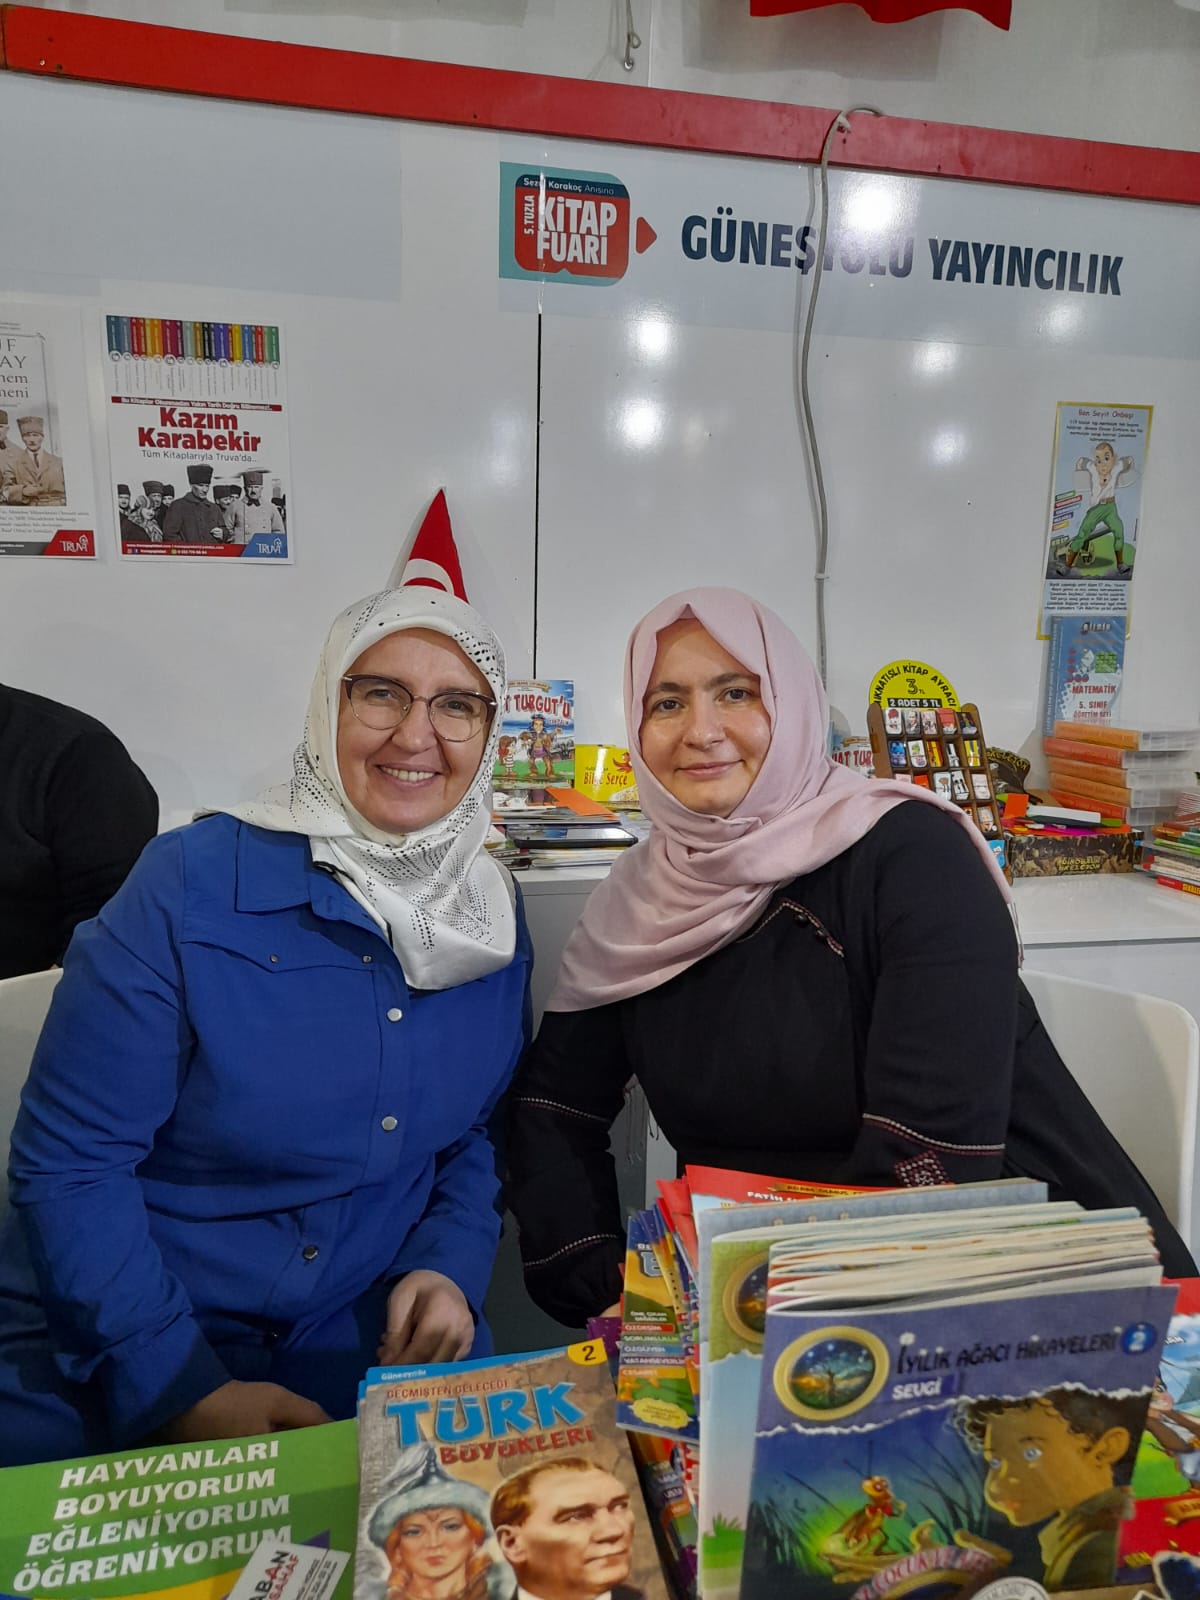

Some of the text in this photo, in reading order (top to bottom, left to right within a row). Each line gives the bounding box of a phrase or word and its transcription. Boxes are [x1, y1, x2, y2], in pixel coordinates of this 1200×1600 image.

[548, 181, 582, 193] Karakoç
[584, 183, 615, 195] Anısına
[523, 195, 535, 224] TUZLA
[539, 196, 617, 236] KİTAP
[537, 231, 608, 266] FUARI
[928, 237, 1124, 296] YAYINCILIK
[160, 406, 238, 430] Kazım
[138, 427, 261, 452] Karabekir
[142, 449, 161, 458] Tüm
[163, 451, 213, 462] Kitaplarıyla
[873, 662, 957, 707] IKNATISLI KİTAP AYRACI
[906, 678, 919, 695] 3
[1072, 683, 1117, 695] MATEMATİK
[513, 694, 570, 719] TURGUT'U
[890, 699, 897, 707] 2
[897, 699, 920, 707] ADET
[931, 699, 941, 708] TL
[582, 1345, 596, 1362] 2
[956, 1343, 1009, 1368] AĞACI
[891, 1376, 943, 1400] SEVGİ
[385, 1381, 585, 1448] TÜRK
[439, 1425, 595, 1466] BÜYÜKLERİ
[59, 1439, 280, 1489] HAYVANLARI
[53, 1468, 276, 1520] BOYUYORUM
[26, 1493, 290, 1557] EĞLENİYORUM
[13, 1524, 291, 1592] ÖĞRENİYORUM
